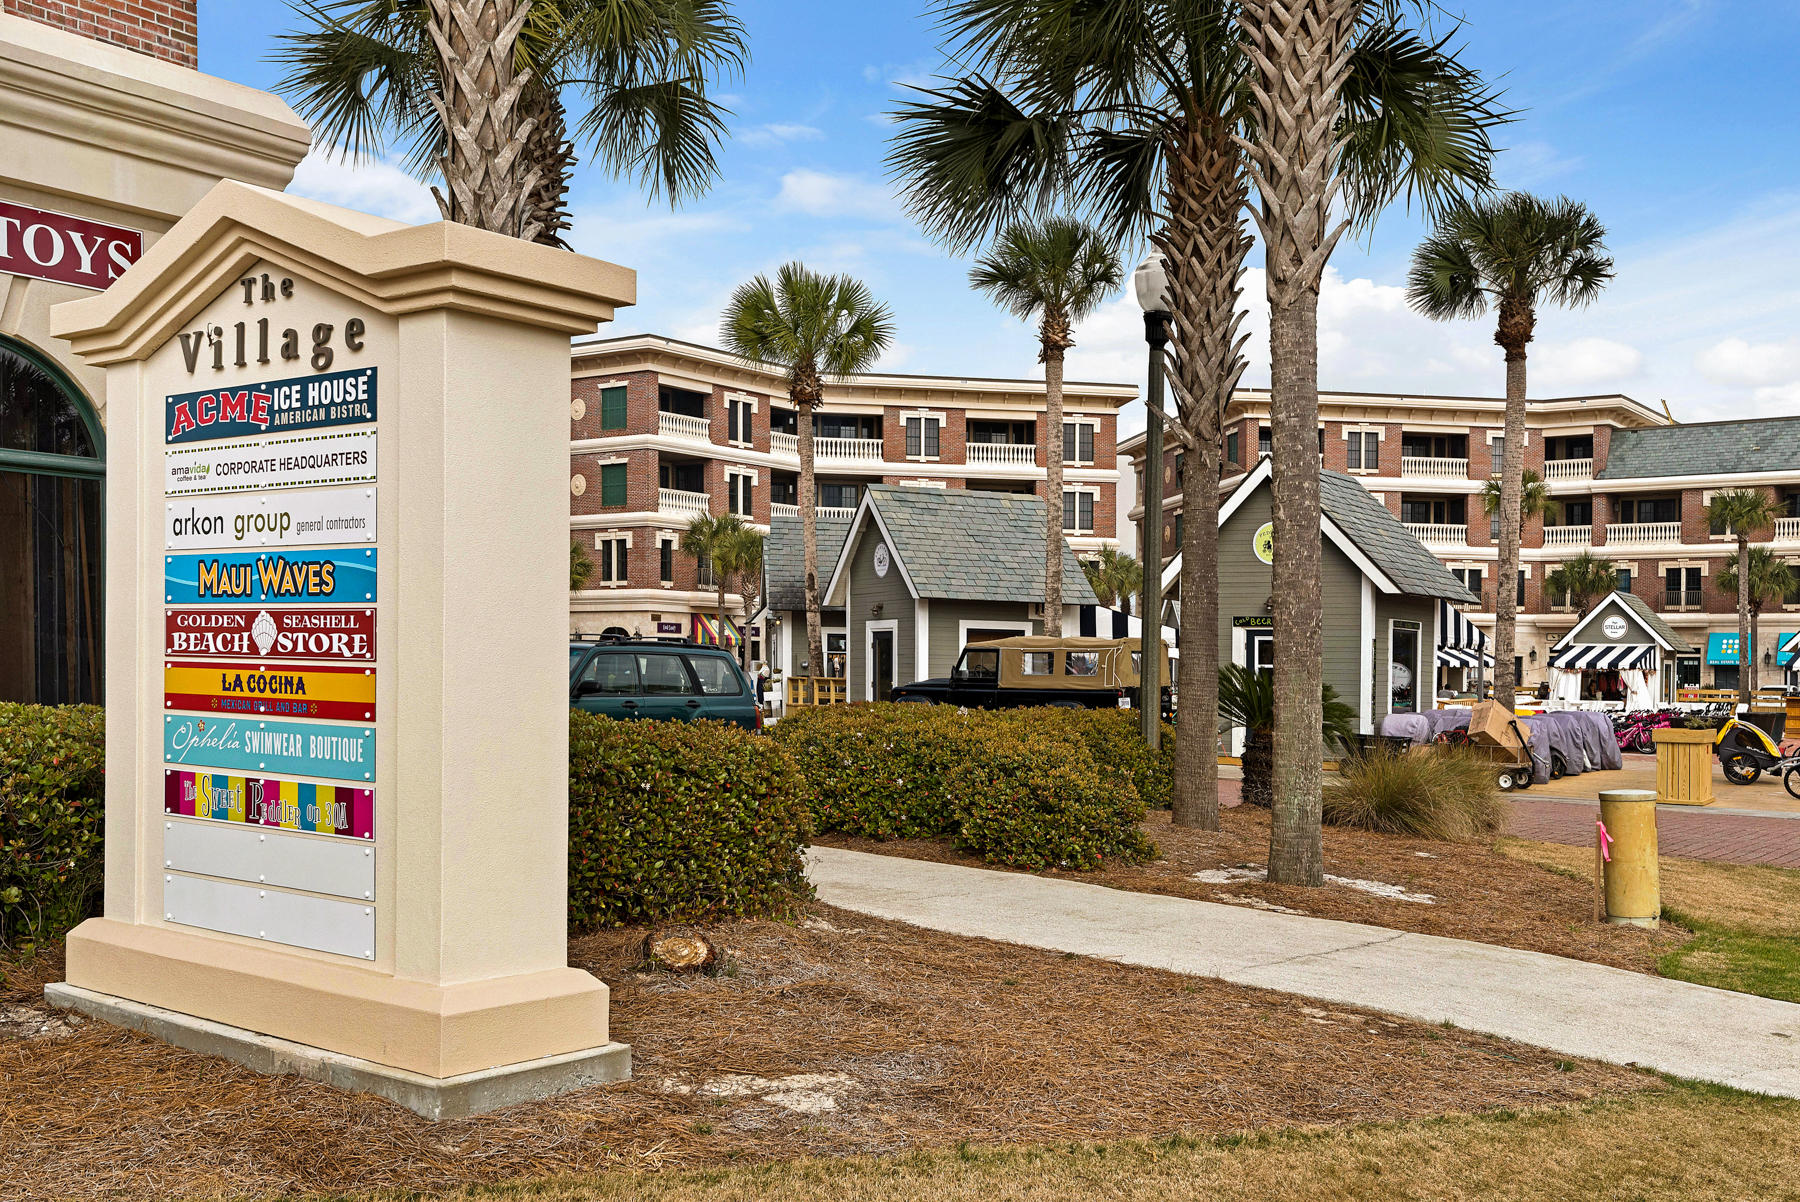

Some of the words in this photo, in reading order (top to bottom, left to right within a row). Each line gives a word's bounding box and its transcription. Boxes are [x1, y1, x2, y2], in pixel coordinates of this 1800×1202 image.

[0, 215, 132, 279] TOYS
[240, 273, 294, 305] The
[178, 317, 366, 374] Village
[171, 391, 272, 438] ACME
[273, 384, 301, 410] ICE
[308, 375, 368, 406] HOUSE
[274, 407, 326, 426] AMERICAN
[330, 402, 368, 419] BISTRO
[171, 461, 207, 475] amavida
[215, 458, 277, 476] CORPORATE
[279, 450, 368, 471] HEADQUARTERS
[173, 507, 224, 536] arkon
[234, 511, 290, 540] group
[296, 515, 324, 535] general
[326, 516, 366, 530] contractors
[177, 614, 246, 628] GOLDEN
[283, 614, 359, 629] SEASHELL
[171, 631, 251, 654] BEACH
[277, 631, 368, 657] STORE
[221, 673, 245, 692] LA
[247, 674, 306, 695] COCINA
[221, 699, 251, 710] MEXICAN
[276, 701, 290, 712] AND
[292, 702, 308, 713] BAR
[172, 721, 241, 762] Ophelia
[244, 730, 302, 757] SWIMWEAR
[309, 736, 364, 763] BOUTIQUE
[325, 801, 348, 829] 30A
